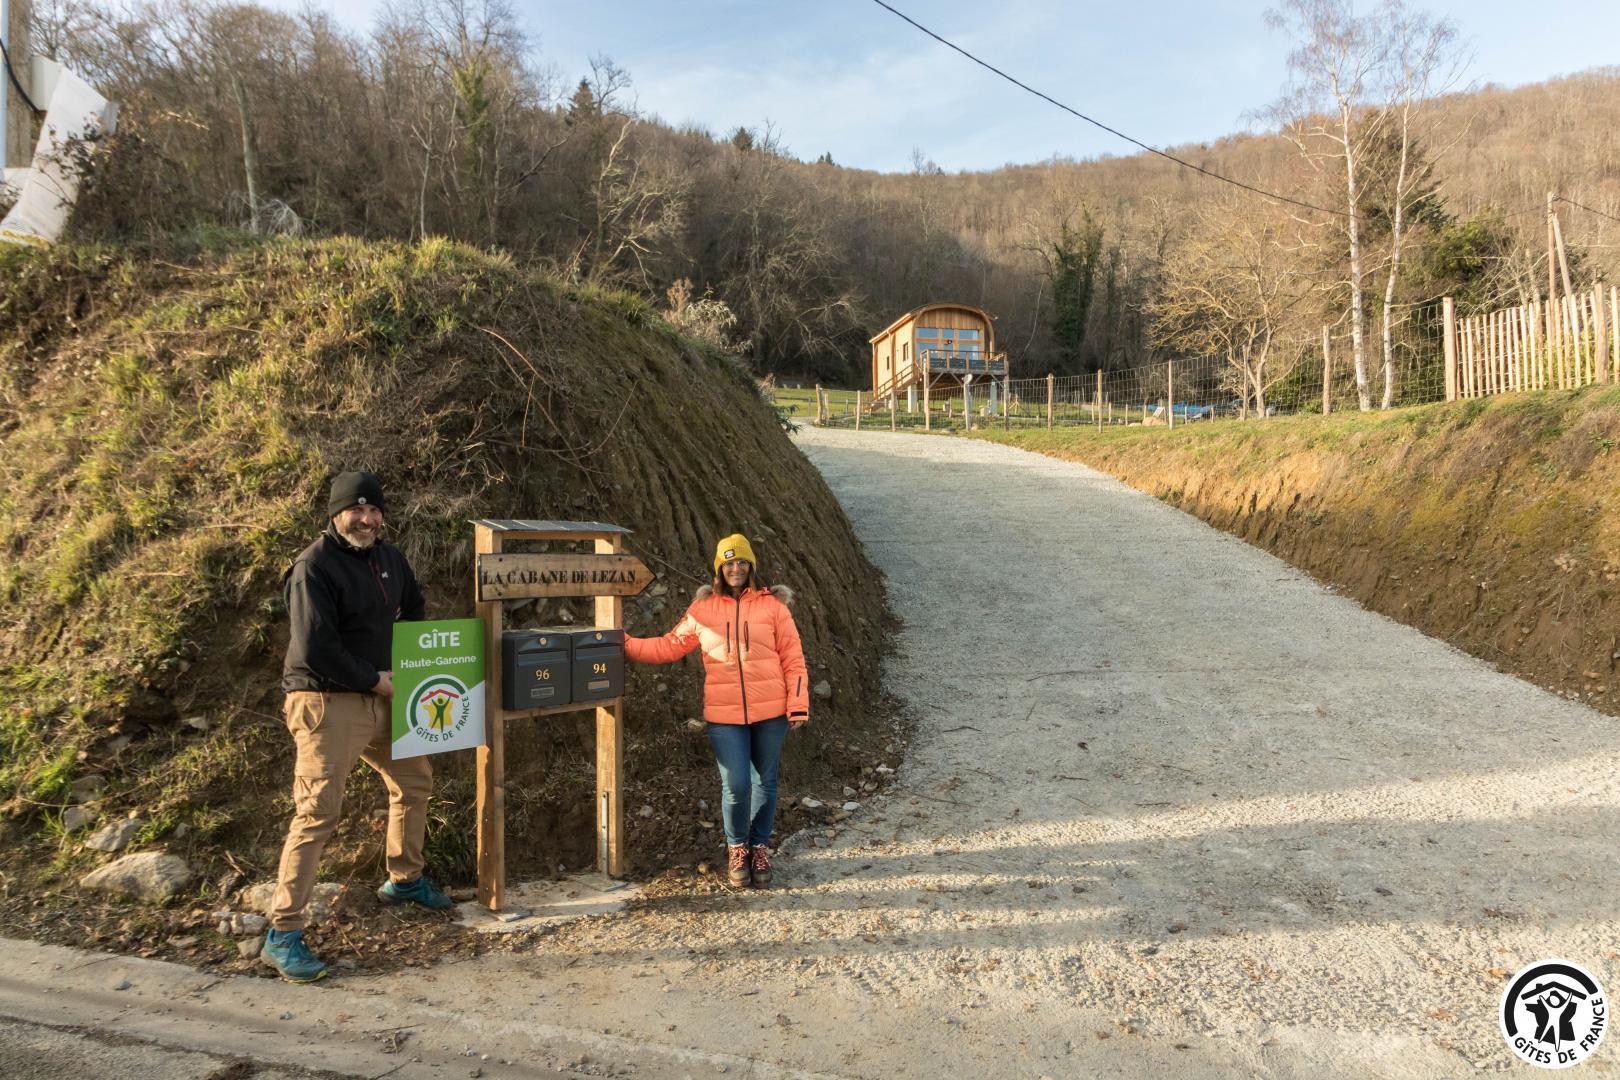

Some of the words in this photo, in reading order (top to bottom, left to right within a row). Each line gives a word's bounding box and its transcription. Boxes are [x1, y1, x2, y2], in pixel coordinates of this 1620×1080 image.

[484, 570, 504, 584] LA
[507, 570, 568, 584] CABANE
[572, 570, 588, 584] DE
[592, 570, 635, 583] LEZAN
[418, 628, 460, 648] GÎTE
[400, 654, 476, 668] Haute-Garonne
[536, 669, 550, 680] 96
[593, 663, 606, 674] 94
[416, 726, 439, 742] GÎTES
[443, 730, 454, 742] DE
[456, 696, 470, 731] FRANCE
